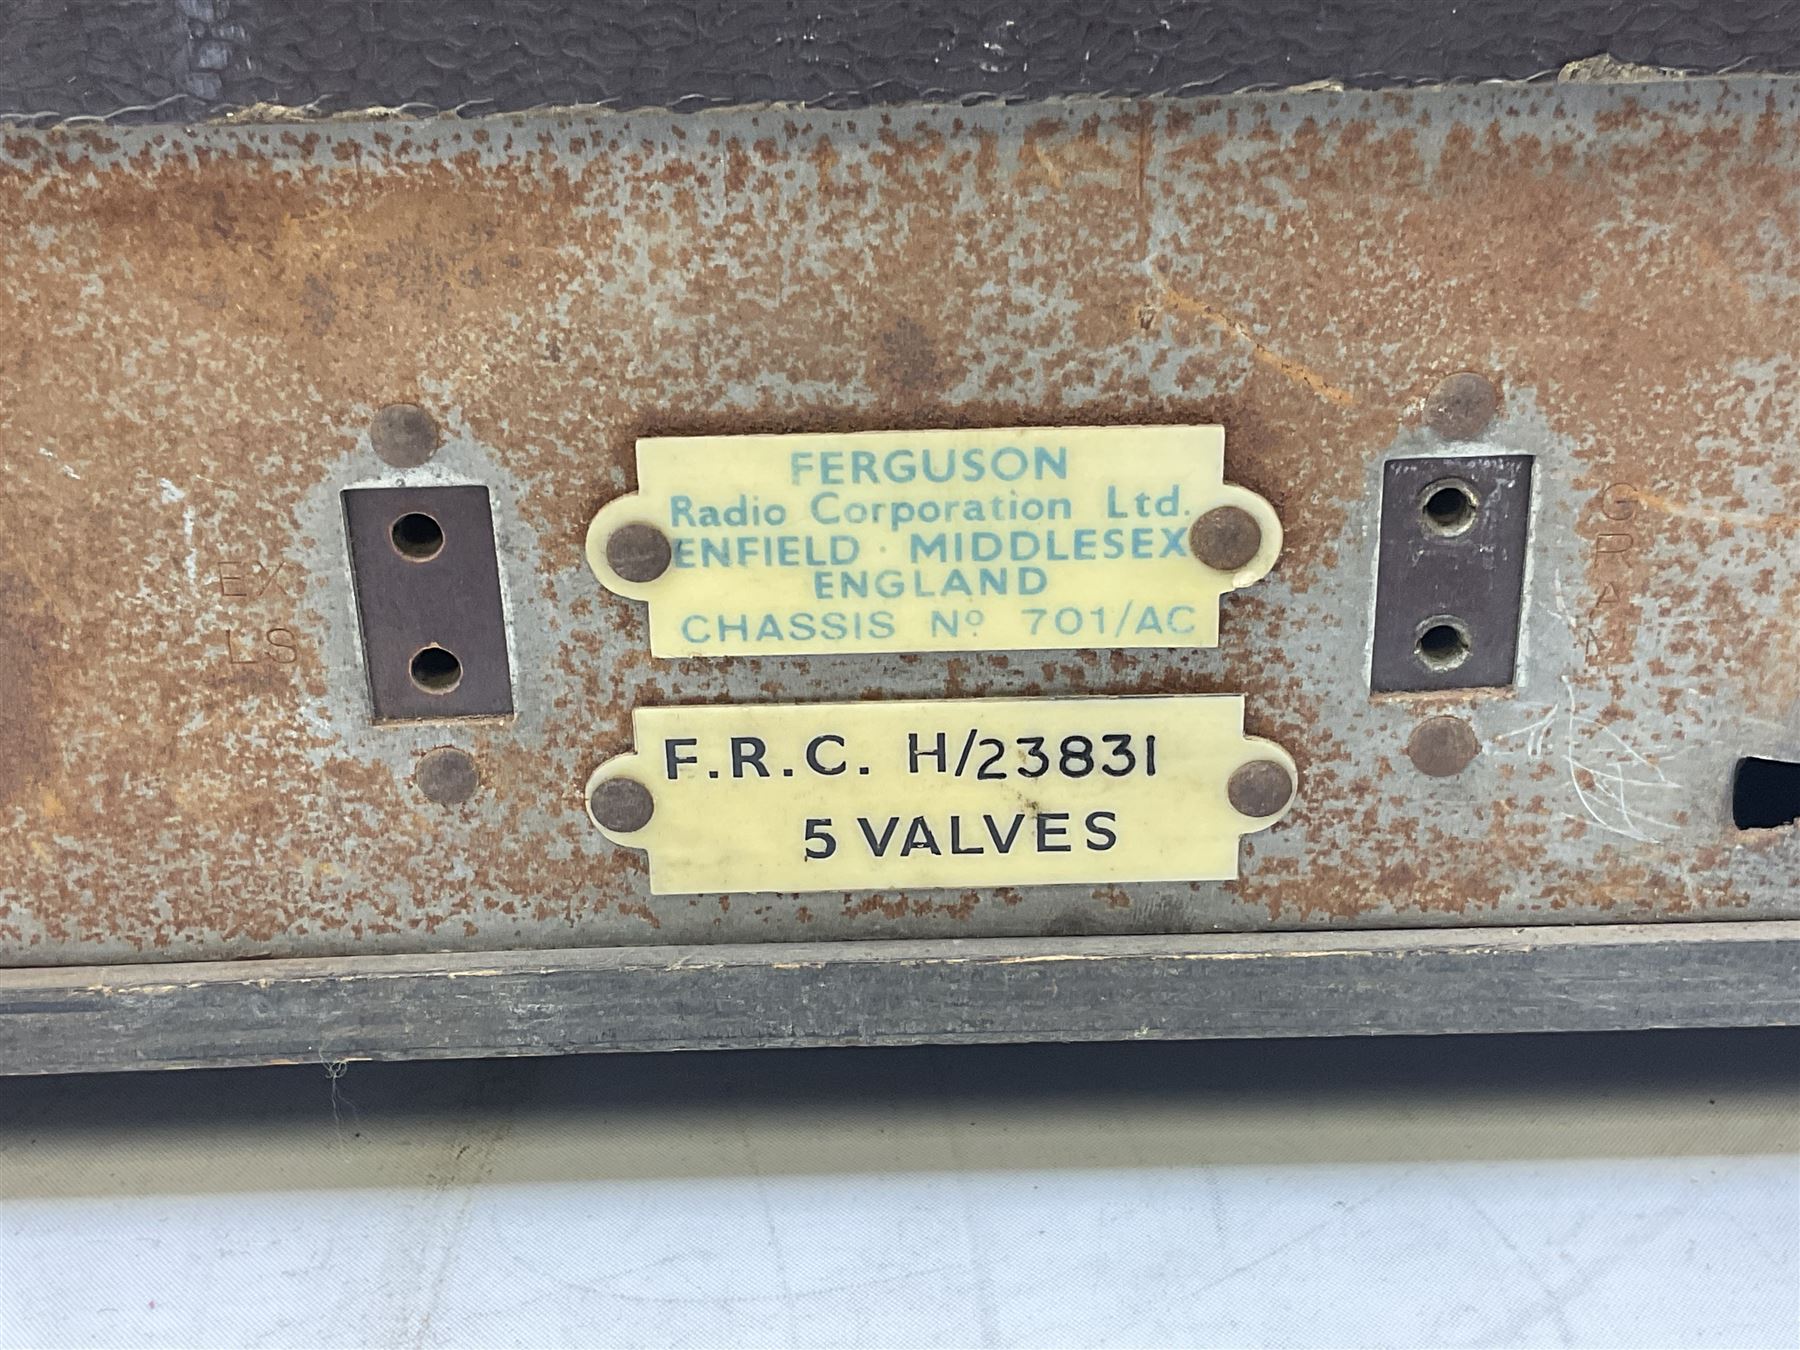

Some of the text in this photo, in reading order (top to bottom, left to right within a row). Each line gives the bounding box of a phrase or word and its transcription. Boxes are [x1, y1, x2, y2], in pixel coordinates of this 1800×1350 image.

[790, 446, 1067, 486] FERGUSON
[670, 484, 1190, 532] Radio Corporation Ltd.
[673, 526, 1189, 568] ENFIELD MIDDLESEX
[217, 560, 288, 596] EX
[814, 566, 1048, 599] ENGLAND
[681, 611, 896, 643] CHASSIS
[1020, 600, 1196, 638] 701/AC
[225, 627, 297, 663] LS
[664, 728, 1156, 781] F.R.C. H/23831
[803, 811, 1118, 861] 5 VALVES
